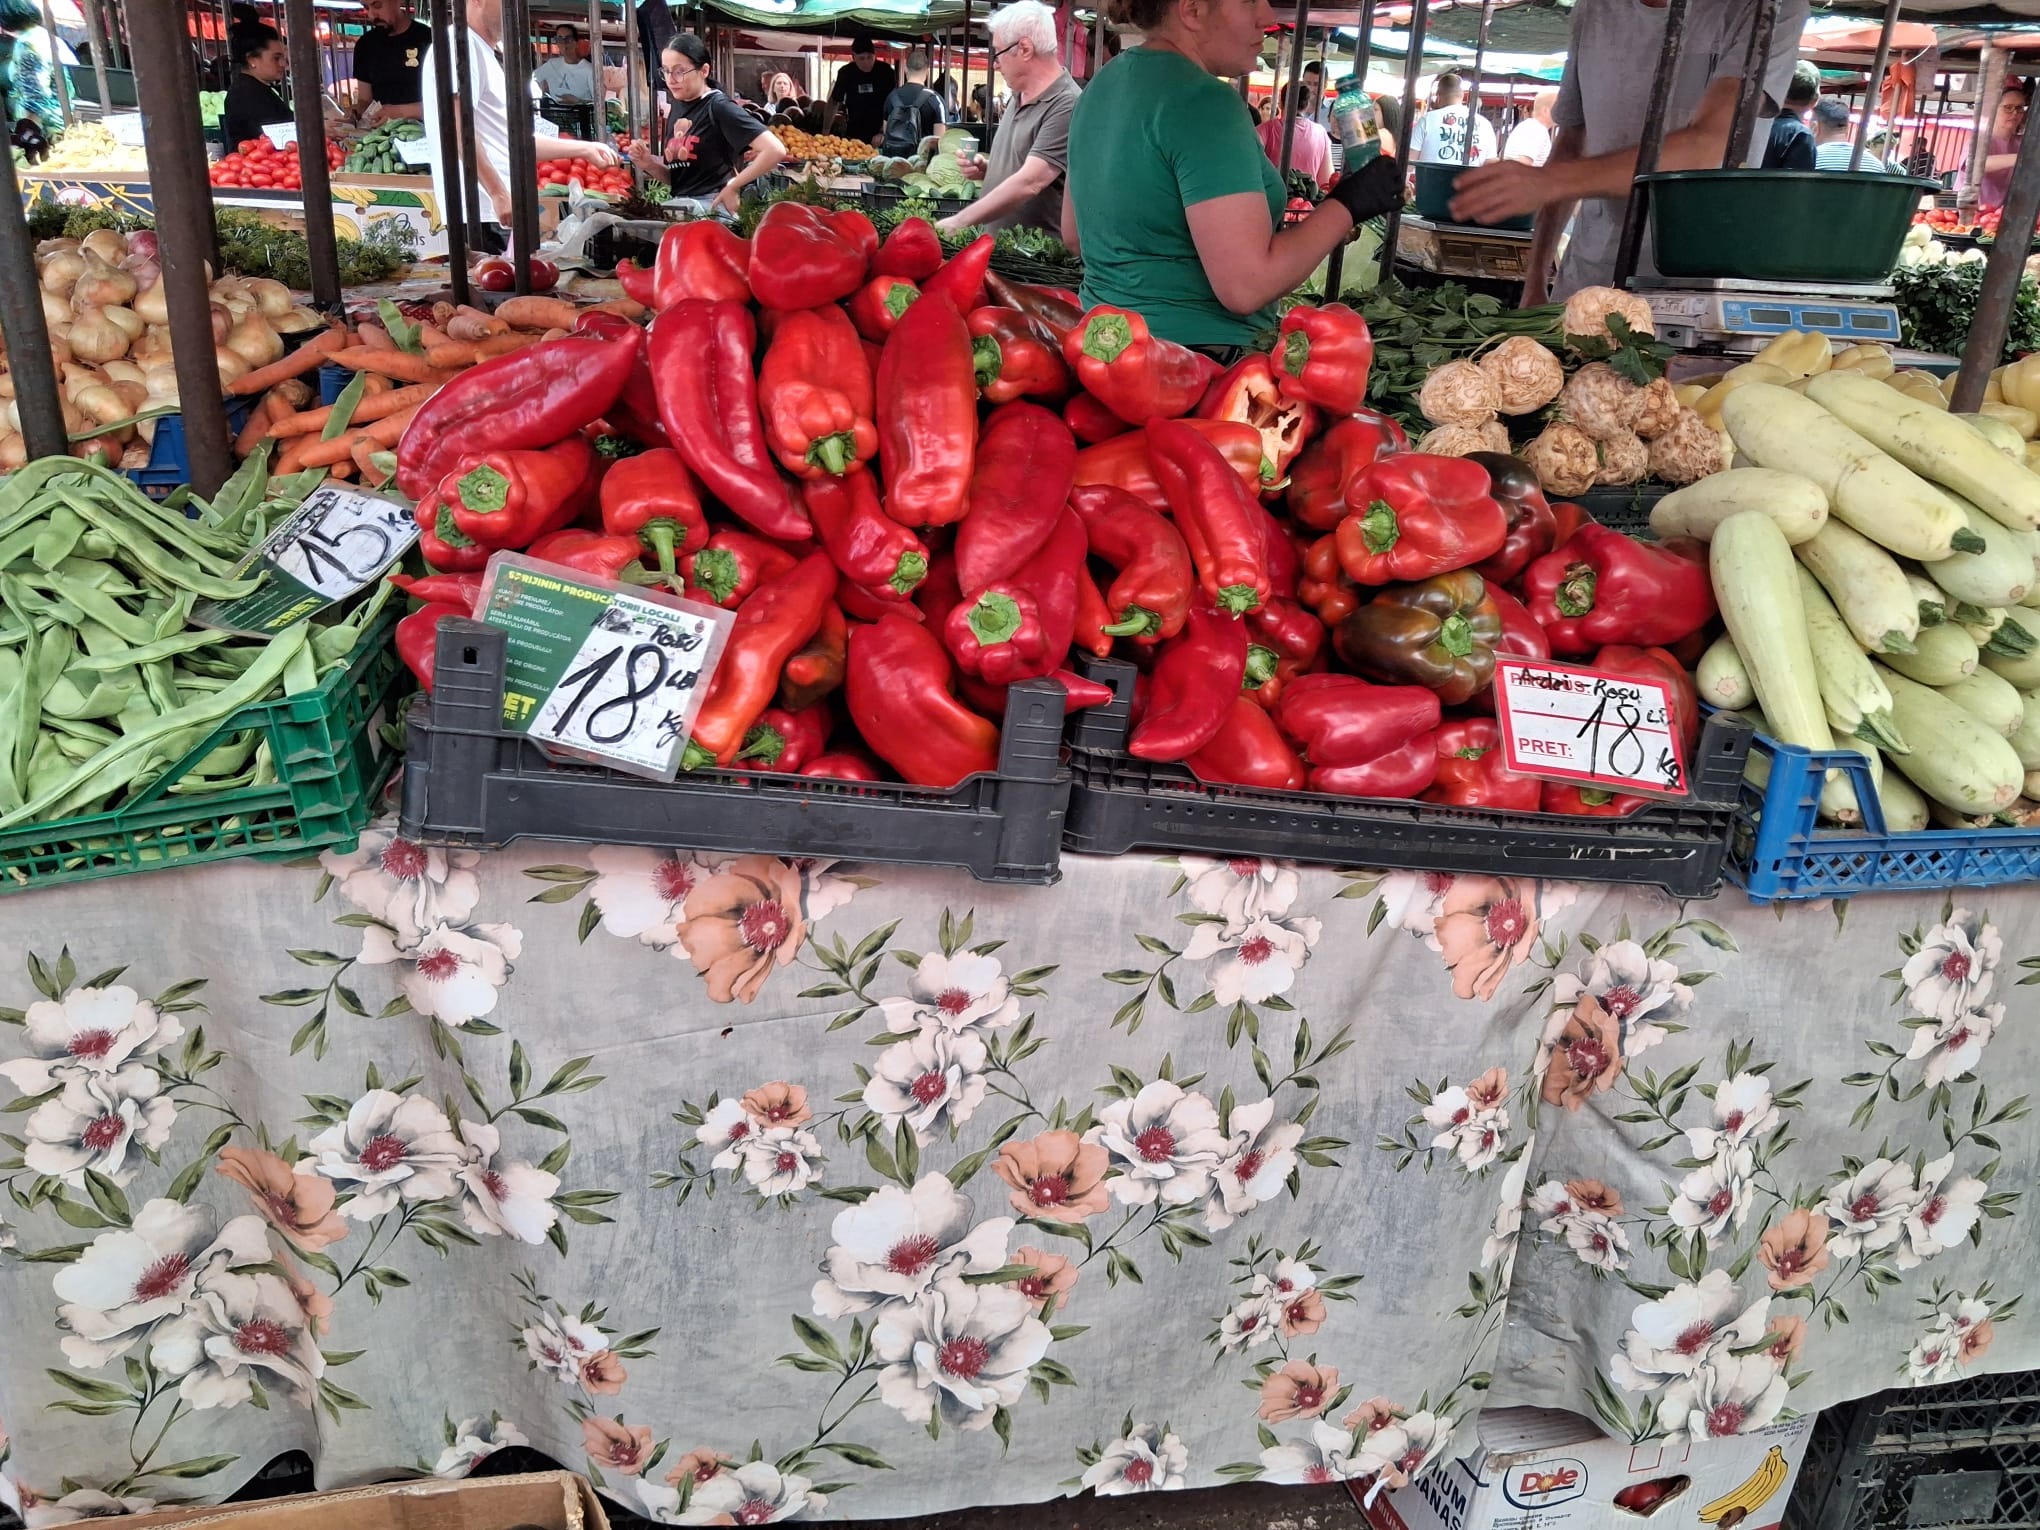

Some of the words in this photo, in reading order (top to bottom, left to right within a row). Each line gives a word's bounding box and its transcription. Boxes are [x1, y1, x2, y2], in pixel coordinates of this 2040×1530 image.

[297, 495, 393, 586] 15
[508, 570, 562, 593] SPRIJINIM
[562, 584, 641, 612] PRODUCĂTORII
[641, 606, 681, 624] LOCALI
[551, 643, 670, 745] 18
[1576, 697, 1645, 779] 18
[1519, 1466, 1579, 1493] Dole
